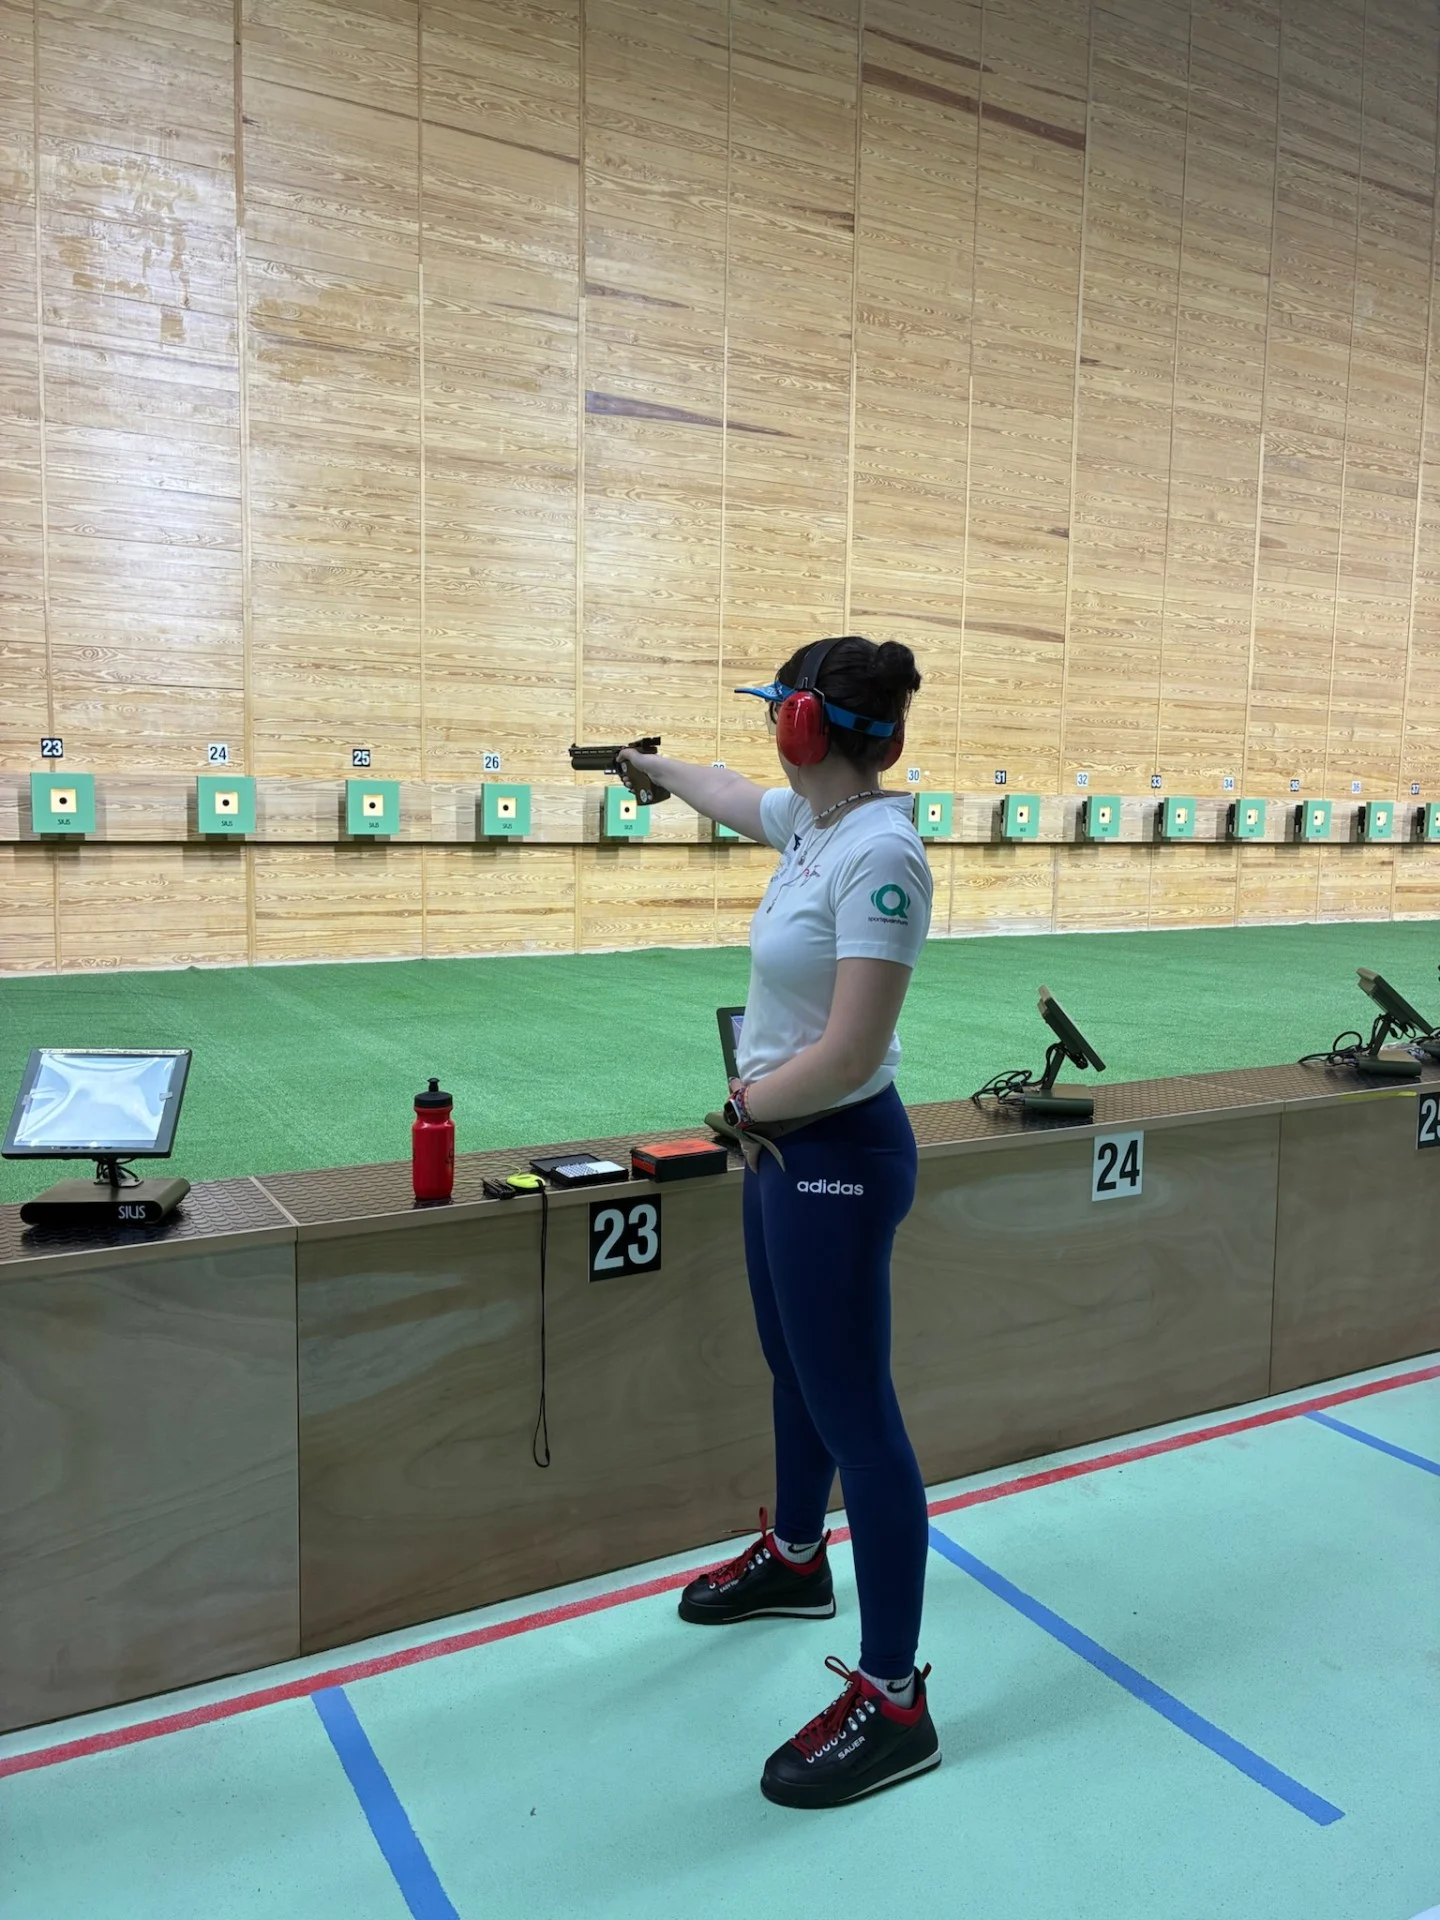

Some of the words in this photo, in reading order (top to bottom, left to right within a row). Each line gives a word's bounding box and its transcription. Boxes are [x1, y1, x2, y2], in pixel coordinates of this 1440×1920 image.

[42, 739, 62, 756] 23
[210, 746, 227, 760] 24
[353, 751, 370, 766] 25
[485, 756, 499, 769] 26
[908, 769, 920, 782] 30
[995, 771, 1006, 784] 31
[1077, 774, 1088, 785] 32
[1151, 776, 1162, 787] 33
[1224, 778, 1233, 789] 34
[1420, 1098, 1440, 1142] 2
[1097, 1140, 1140, 1192] 24
[797, 1179, 864, 1195] adidas
[118, 1205, 146, 1219] SIUS
[594, 1203, 658, 1271] 23
[838, 1736, 865, 1760] SAUER
